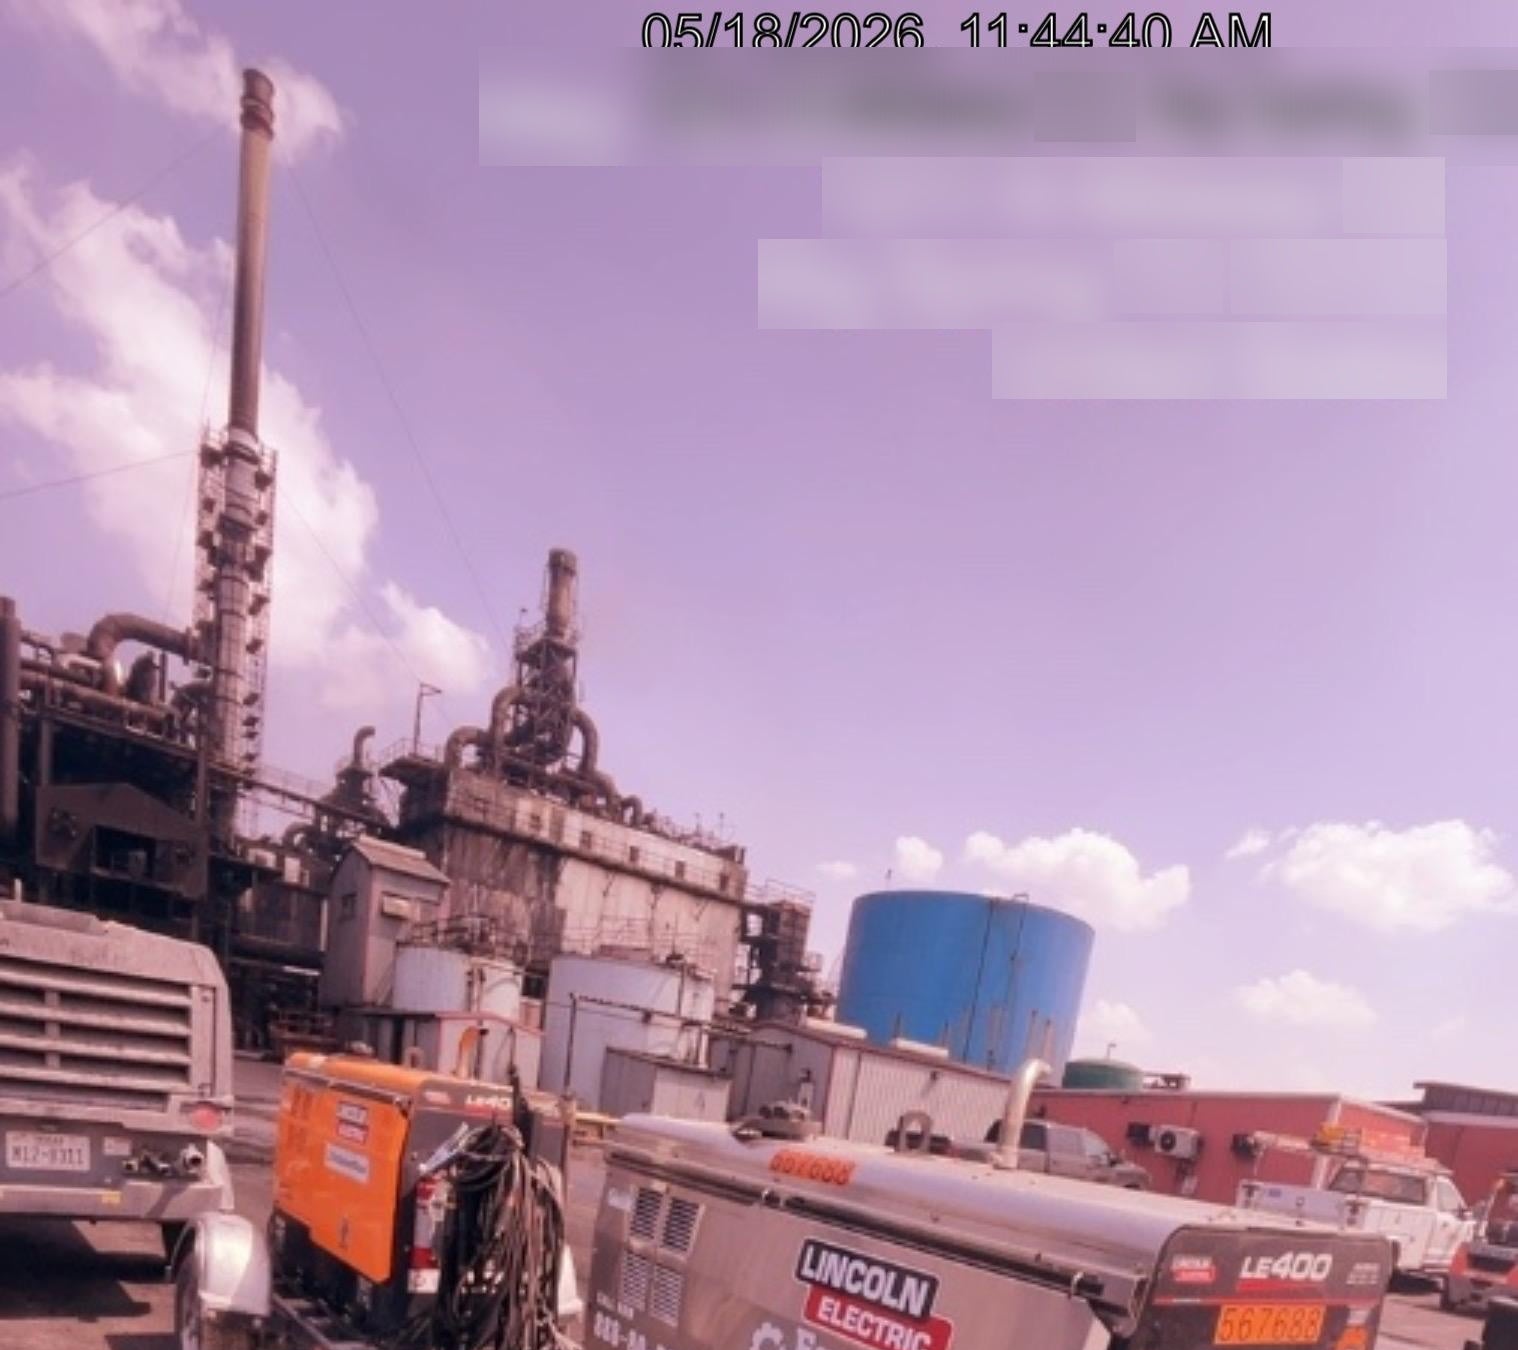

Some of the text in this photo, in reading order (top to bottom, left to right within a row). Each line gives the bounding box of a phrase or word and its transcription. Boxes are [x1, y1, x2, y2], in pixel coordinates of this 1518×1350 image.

[801, 1244, 930, 1317] LINCOLN
[1238, 1251, 1333, 1282] LE400
[1218, 1306, 1322, 1341] 567688
